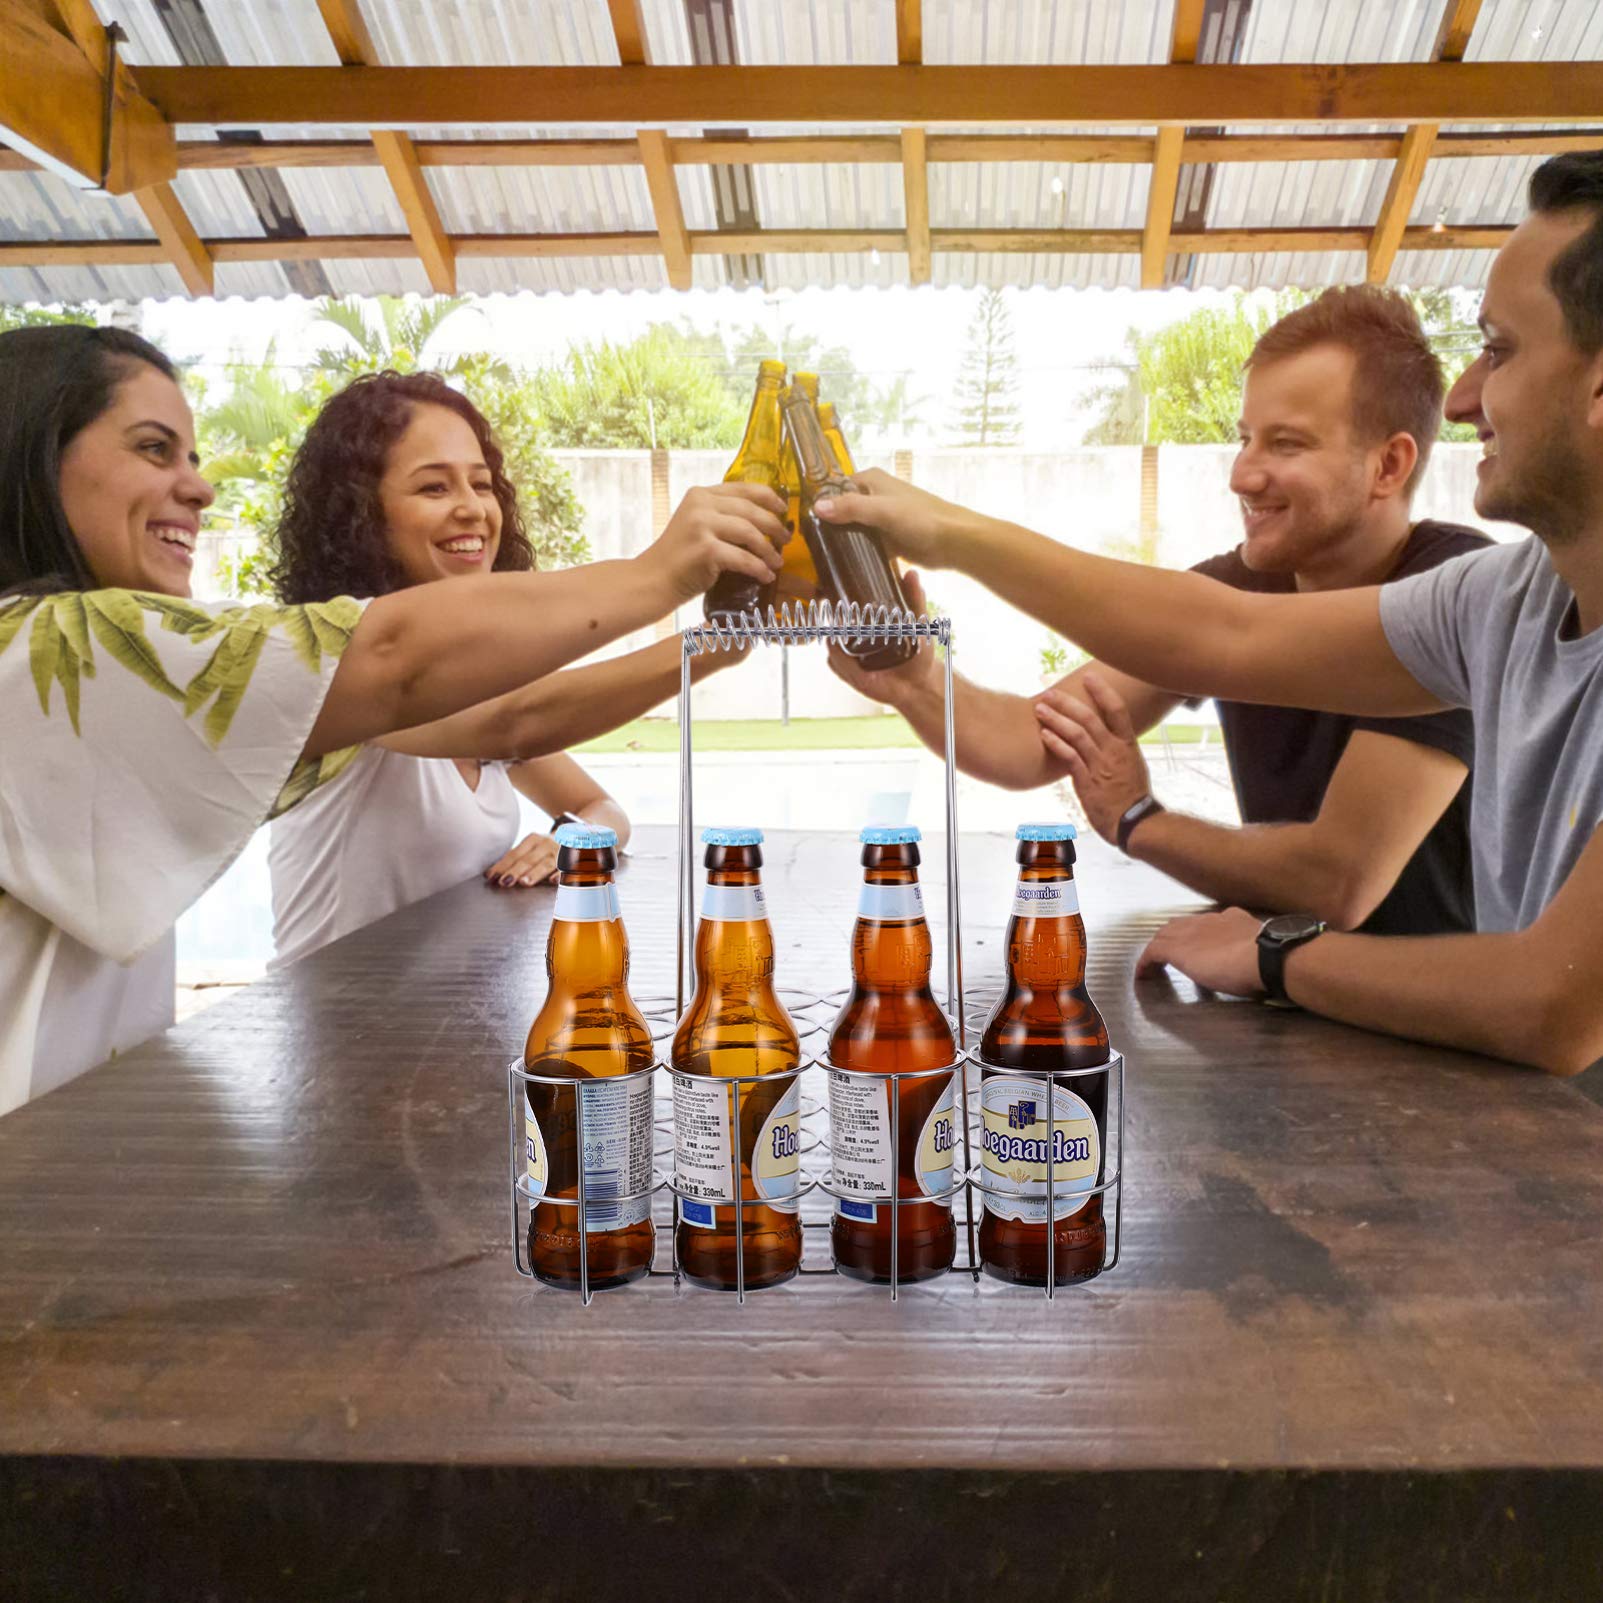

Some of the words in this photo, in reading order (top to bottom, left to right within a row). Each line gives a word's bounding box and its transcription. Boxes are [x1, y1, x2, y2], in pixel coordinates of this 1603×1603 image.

[1016, 886, 1061, 901] oegaarden
[981, 1115, 1090, 1164] oegaarden
[702, 1187, 726, 1198] 330mL
